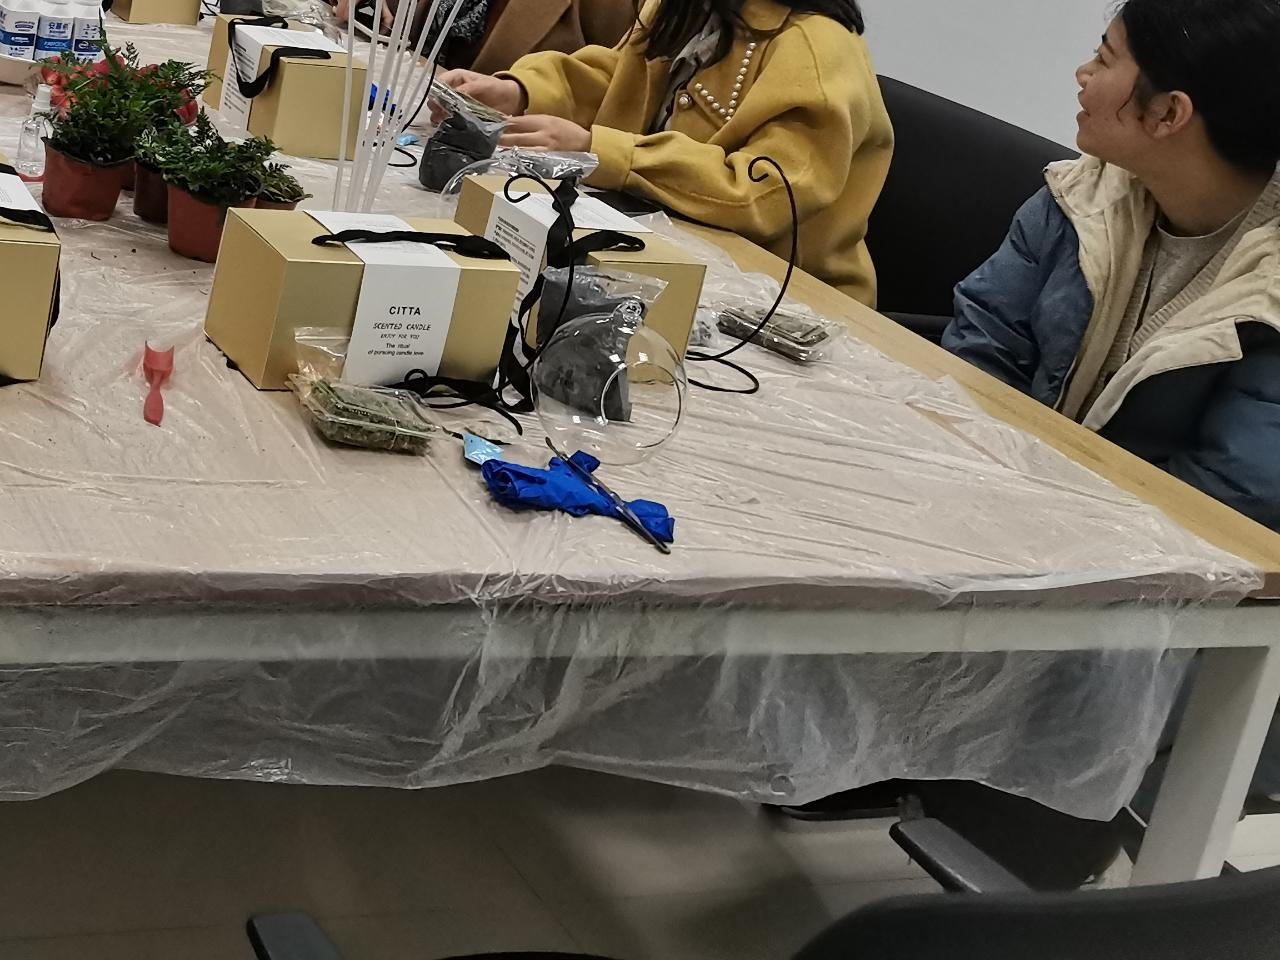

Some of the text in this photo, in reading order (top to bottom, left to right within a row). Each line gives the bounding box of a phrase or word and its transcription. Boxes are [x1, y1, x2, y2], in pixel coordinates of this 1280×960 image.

[389, 306, 421, 316] CITTA
[373, 322, 432, 331] SCENTED CANDLE
